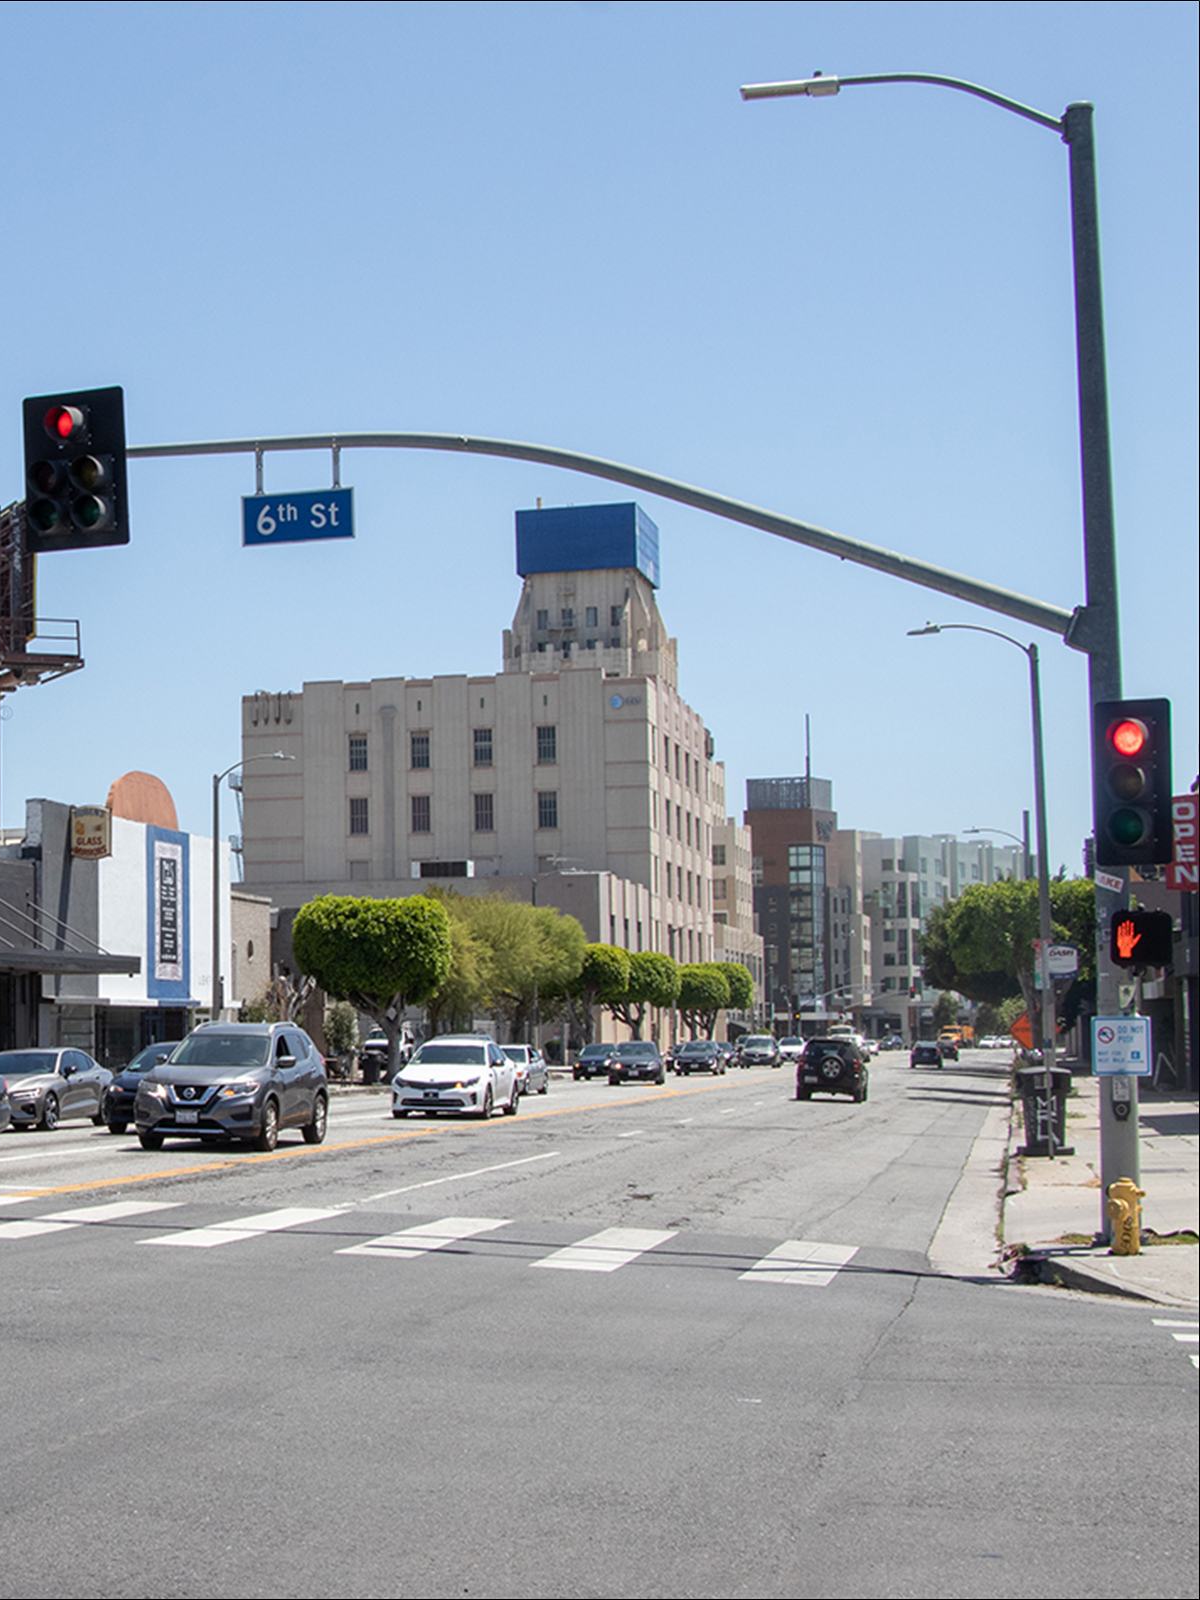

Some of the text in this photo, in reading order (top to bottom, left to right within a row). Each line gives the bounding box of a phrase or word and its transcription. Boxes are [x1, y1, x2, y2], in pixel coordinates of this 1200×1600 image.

[256, 501, 340, 536] 6th St
[76, 836, 103, 846] GLASS
[1172, 801, 1199, 884] OPEN
[1048, 949, 1075, 958] DASH
[1117, 1025, 1144, 1034] DO NOT
[1117, 1035, 1134, 1044] PUSH
